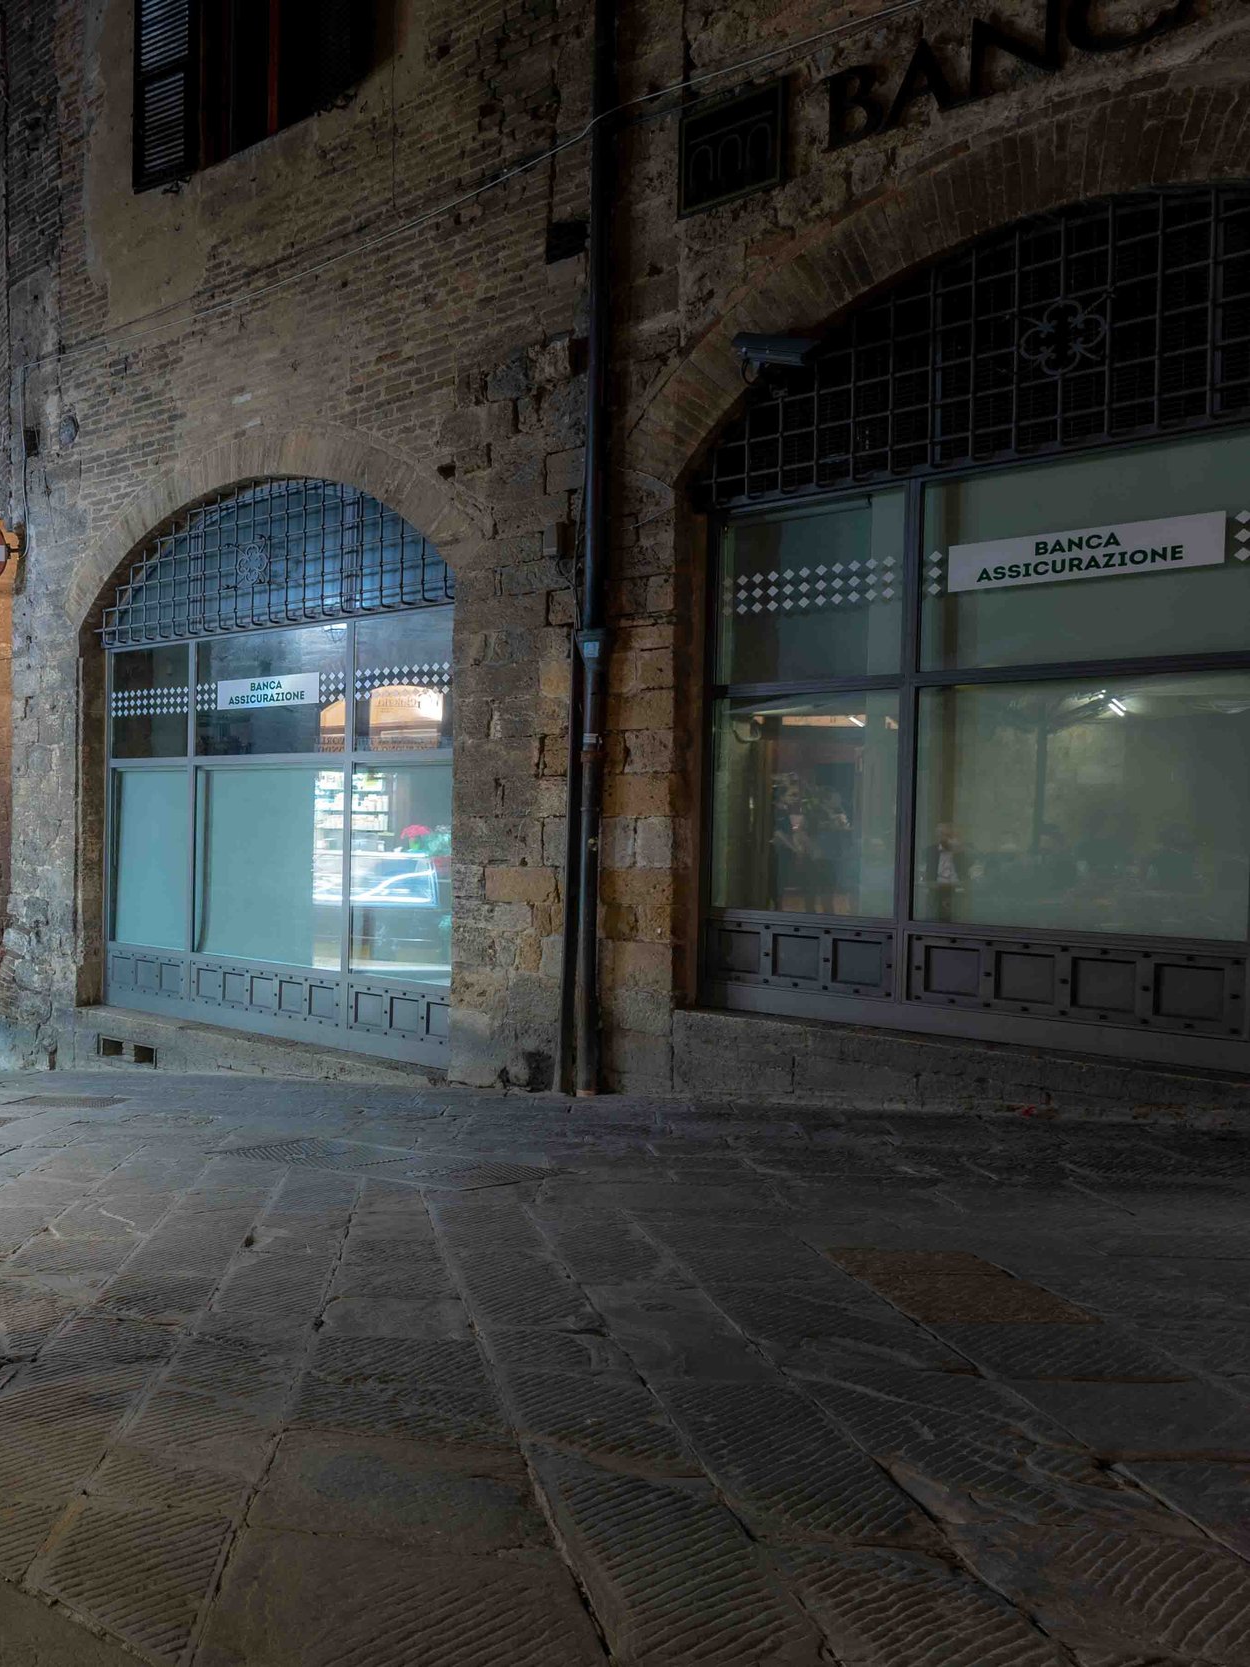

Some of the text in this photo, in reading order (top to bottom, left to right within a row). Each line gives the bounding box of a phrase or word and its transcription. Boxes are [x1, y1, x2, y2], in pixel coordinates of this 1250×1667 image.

[1034, 532, 1121, 556] BANCA
[976, 545, 1184, 582] ASSICURAZIONE
[250, 680, 282, 691] BANCA
[228, 691, 305, 705] ASSICURAZIONE
